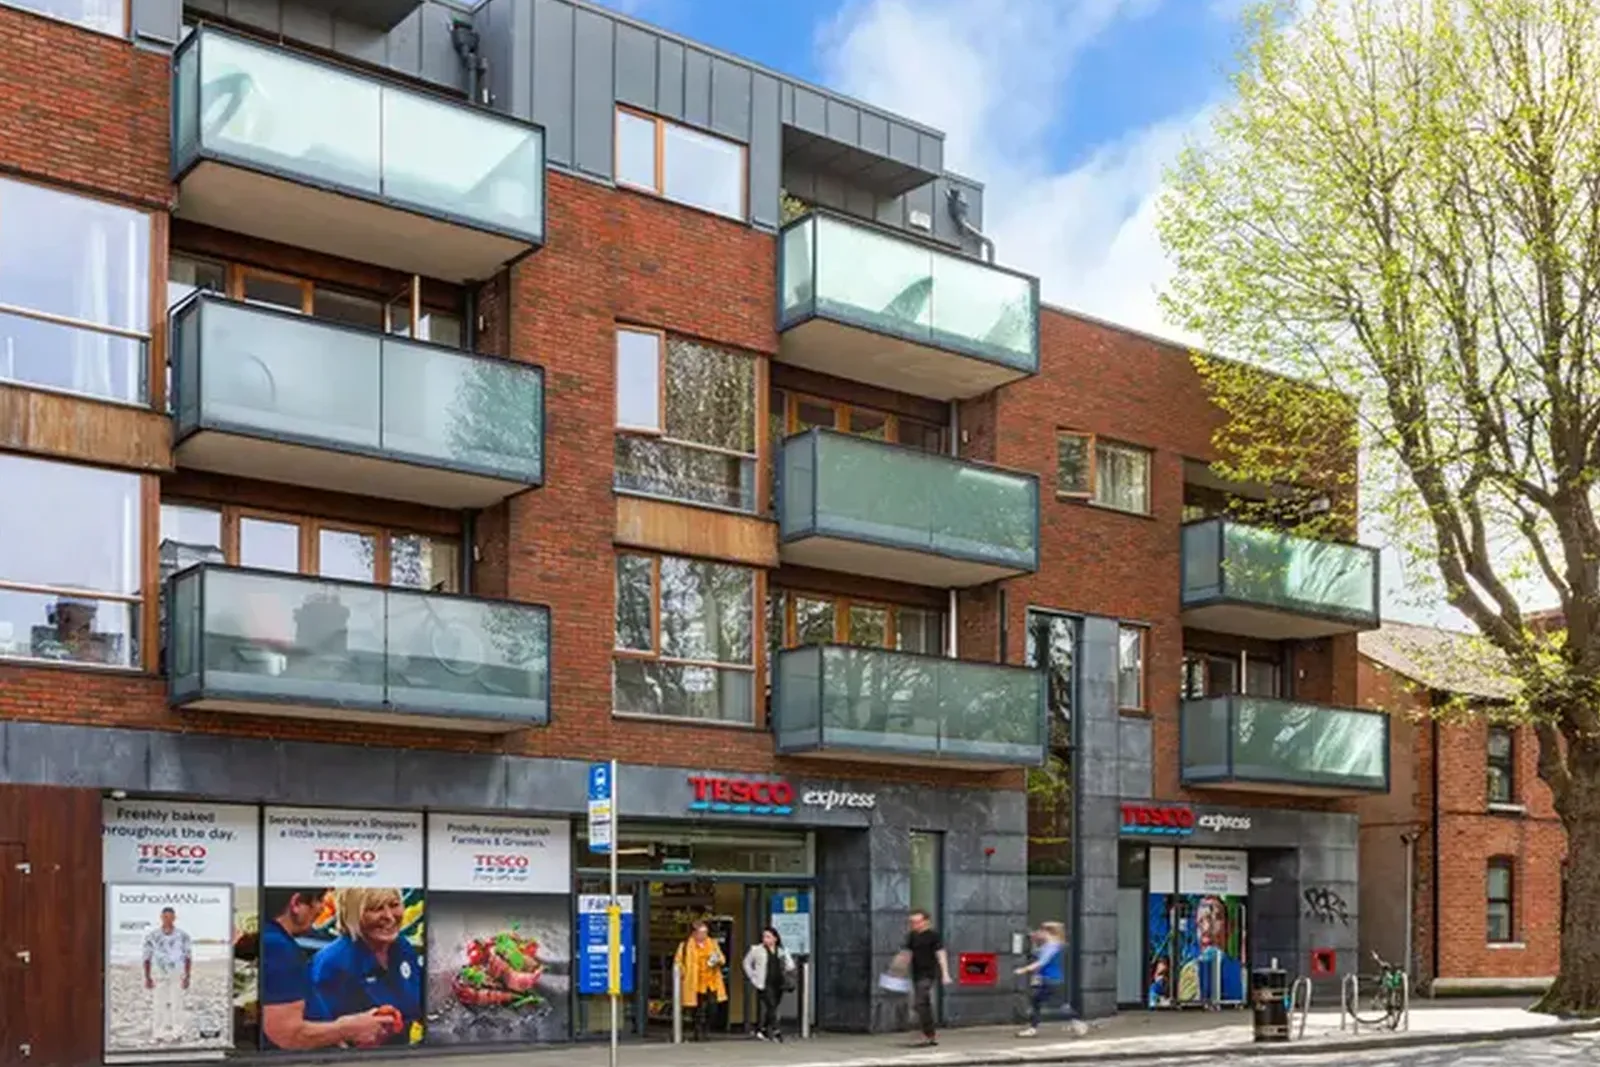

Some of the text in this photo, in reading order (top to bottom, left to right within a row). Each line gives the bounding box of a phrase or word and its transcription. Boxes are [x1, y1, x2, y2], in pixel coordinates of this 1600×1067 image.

[688, 776, 876, 810] TESCO express
[117, 807, 215, 823] Freshly baked
[268, 815, 308, 827] Serving
[1121, 803, 1251, 832] TESCO express
[102, 824, 238, 841] hroughout the day.
[280, 830, 286, 838] a
[317, 829, 350, 839] better
[354, 832, 382, 842] every
[452, 835, 491, 846] Farmers
[138, 843, 206, 858] TESCO
[315, 849, 375, 862] TESCO
[474, 855, 529, 867] TESCO
